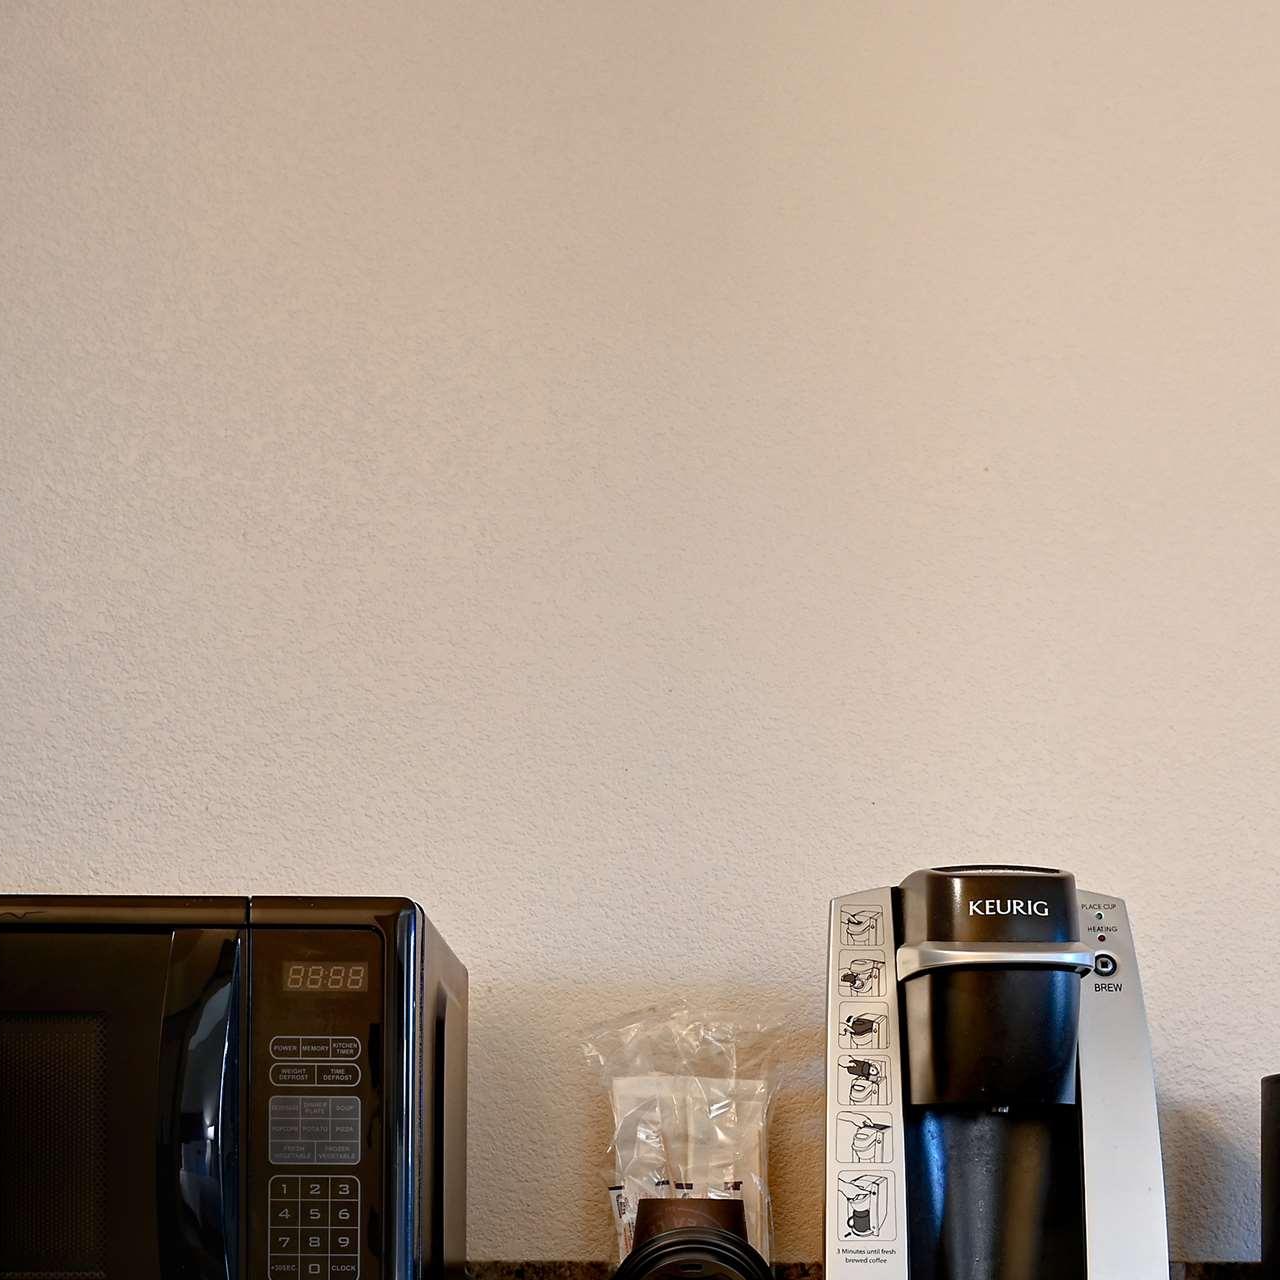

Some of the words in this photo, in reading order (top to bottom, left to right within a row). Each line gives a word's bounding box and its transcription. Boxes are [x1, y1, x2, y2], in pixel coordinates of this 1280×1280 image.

[969, 899, 1049, 917] KEURIG
[1081, 903, 1102, 911] PLACE
[1104, 903, 1117, 911] CUP
[1087, 925, 1118, 933] HEATING
[1094, 983, 1123, 992] BREW
[281, 1184, 287, 1195] 1
[310, 1184, 321, 1195] 2
[339, 1184, 350, 1195] 3
[278, 1208, 290, 1219] 4
[310, 1209, 320, 1219] 5
[338, 1208, 351, 1220] 6
[278, 1237, 290, 1248] 7
[309, 1237, 320, 1248] 8
[338, 1236, 350, 1247] 9
[331, 1264, 357, 1272] CLOCK
